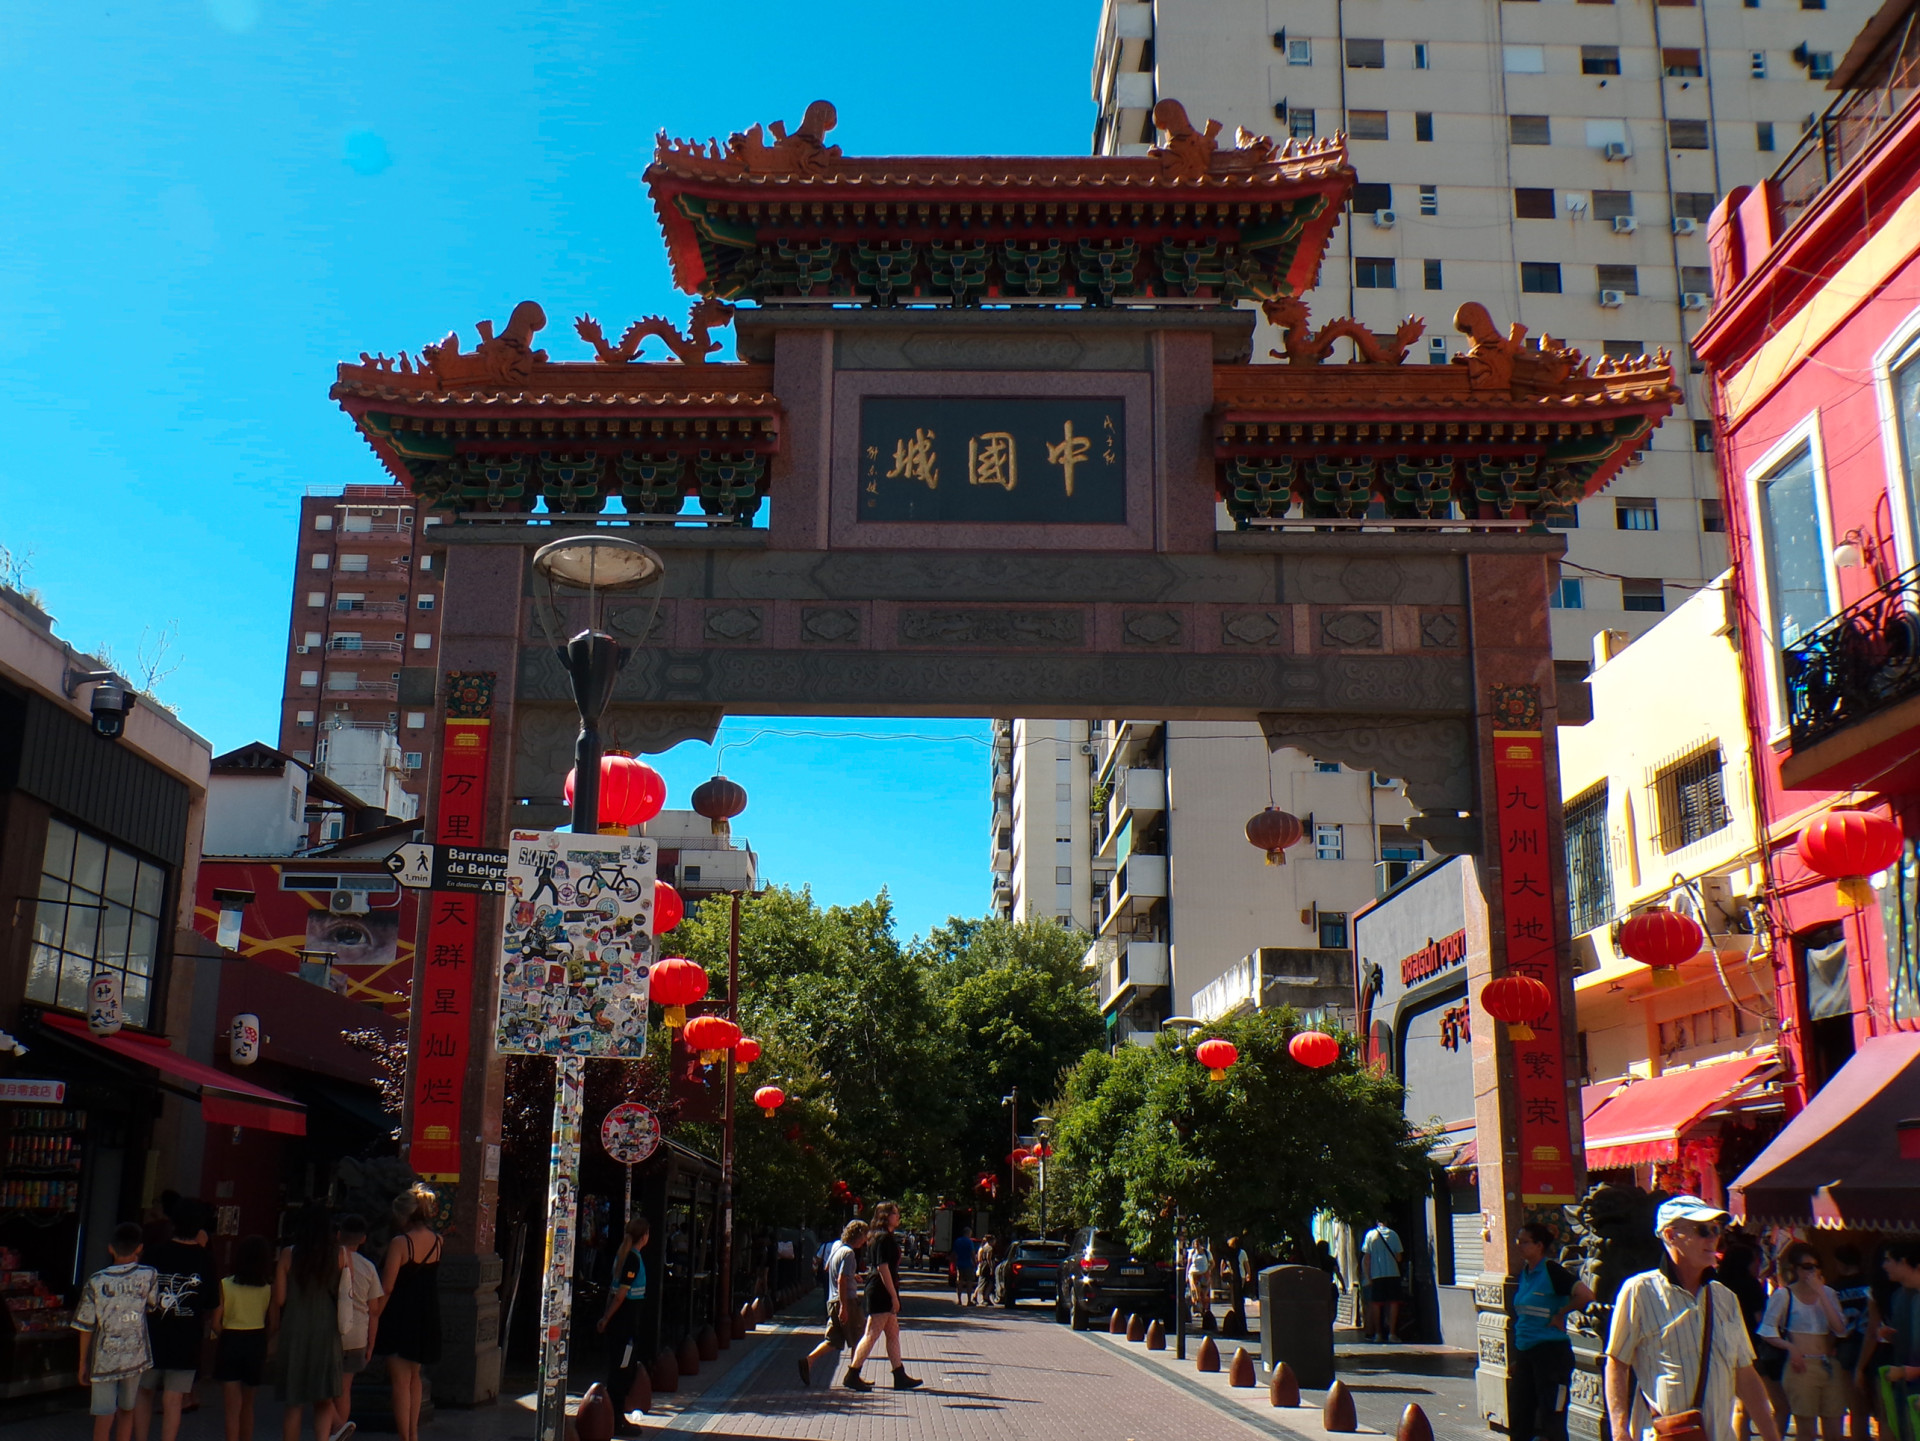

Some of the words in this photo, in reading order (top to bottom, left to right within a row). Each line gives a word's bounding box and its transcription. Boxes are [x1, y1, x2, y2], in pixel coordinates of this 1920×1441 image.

[448, 848, 508, 864] Barranca
[447, 863, 464, 874] de
[468, 863, 509, 878] Belgra
[420, 774, 478, 1105] 万里天群星灿烂
[1440, 928, 1466, 966] PORT
